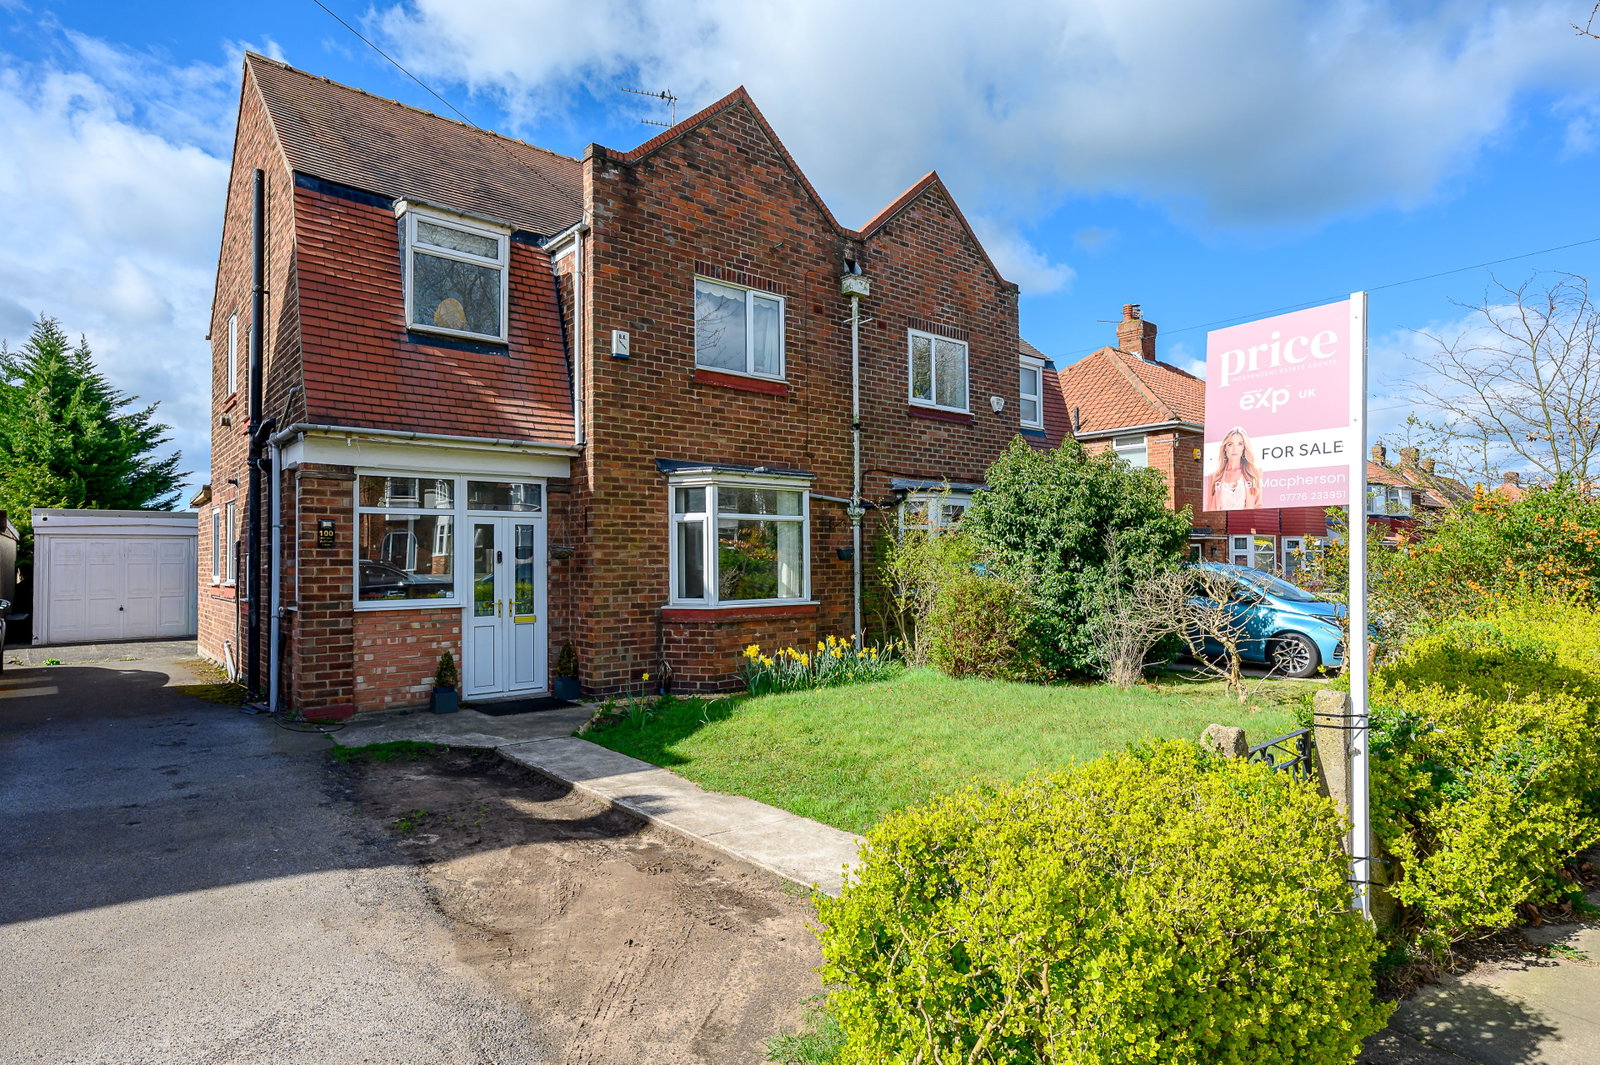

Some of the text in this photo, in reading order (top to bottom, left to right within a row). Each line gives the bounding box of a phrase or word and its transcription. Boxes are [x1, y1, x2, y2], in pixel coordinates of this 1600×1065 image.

[1219, 330, 1338, 388] price
[1231, 359, 1337, 382] INDEPENDENT ESTATE AGENTS
[1240, 388, 1316, 413] exp UK
[1261, 440, 1344, 460] FOR SALE
[1215, 474, 1346, 491] Racel Macpherson
[1280, 490, 1346, 502] 07776 233951
